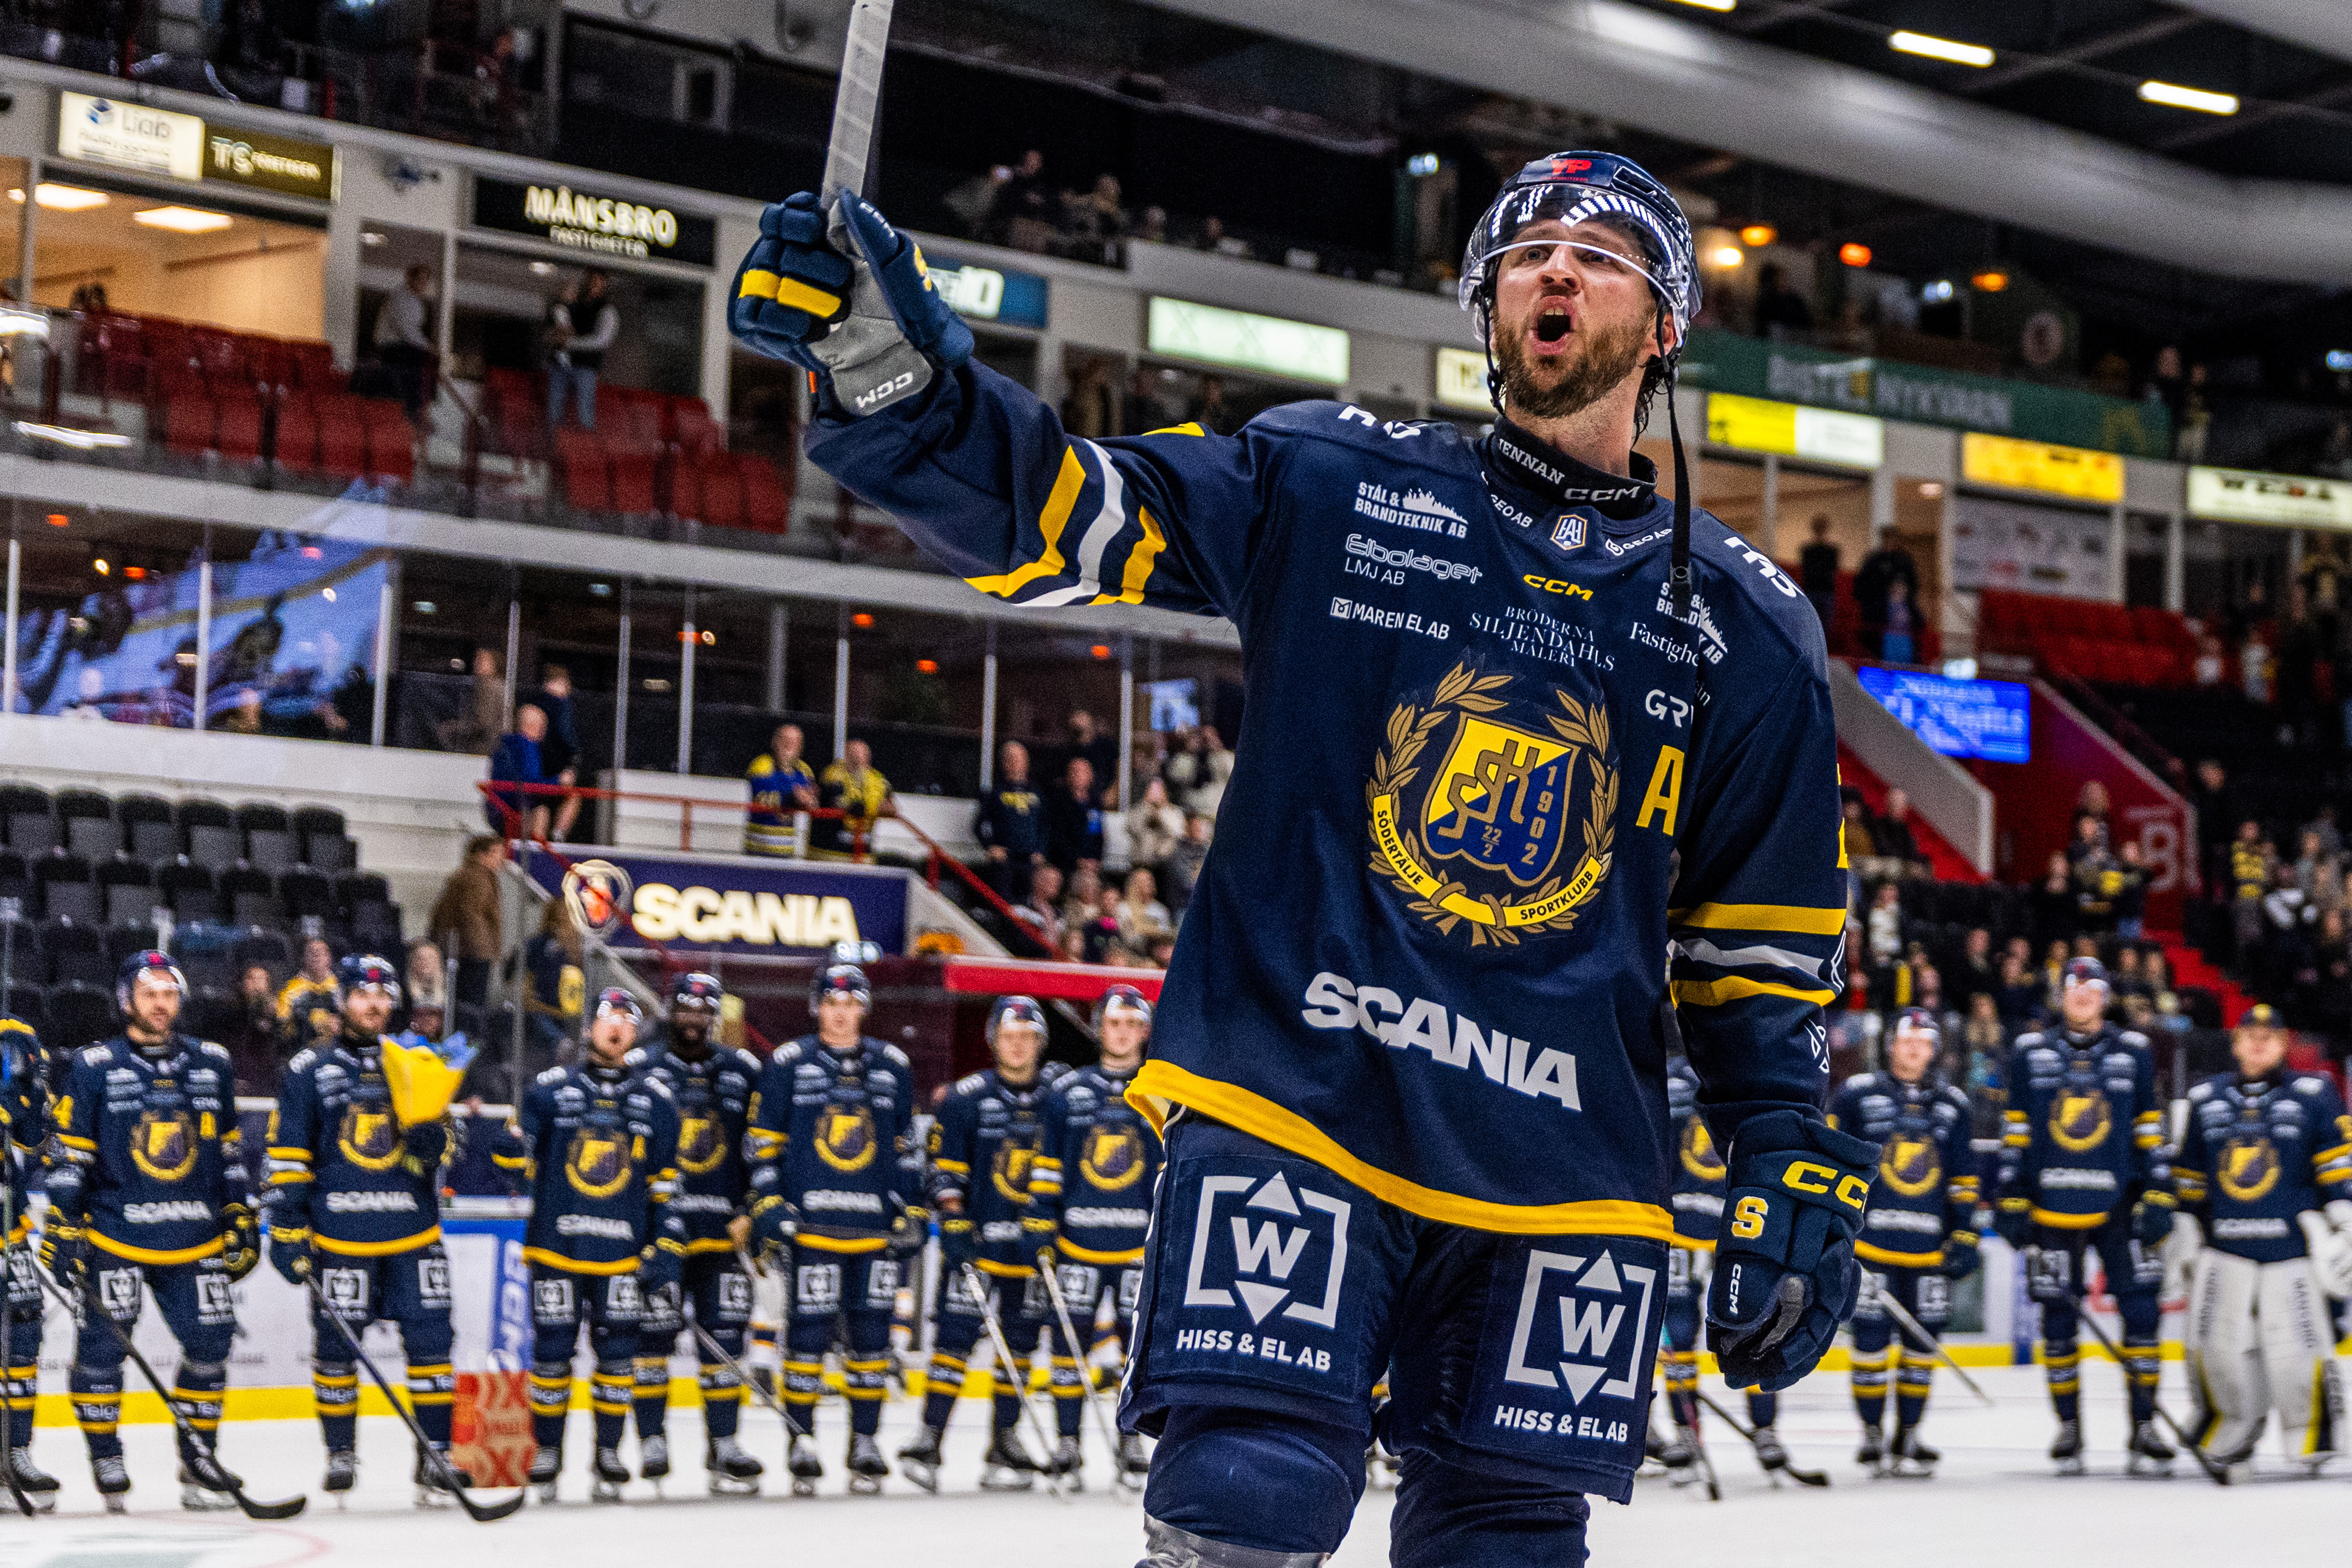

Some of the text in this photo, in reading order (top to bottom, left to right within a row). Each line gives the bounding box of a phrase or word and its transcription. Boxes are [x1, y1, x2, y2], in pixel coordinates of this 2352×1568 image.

[525, 186, 675, 247] MÅNSBRO
[855, 371, 914, 409] CCM
[1358, 482, 1400, 507] STÅL &
[1565, 486, 1641, 501] CCM
[1354, 497, 1468, 539] BRANDTEKNIK AB
[1345, 557, 1405, 585] LMJ AB
[1346, 533, 1483, 584] Elbolaget
[1523, 574, 1594, 601] CCM
[1426, 621, 1450, 639] AB
[1469, 612, 1615, 671] SILJENDAHLS
[1505, 606, 1594, 642] BRÖDERNA
[1703, 644, 1724, 664] AB
[1645, 688, 1694, 728] GR
[1636, 745, 1685, 837] A
[1377, 810, 1424, 885] SÖDERTÄLJE
[632, 882, 861, 946] SCANIA
[1520, 870, 1594, 920] SPORTKLUBB
[1301, 971, 1583, 1112] SCANIA
[326, 1191, 418, 1212] SCANIA
[1782, 1161, 1870, 1213] CC
[124, 1201, 212, 1224] SCANIA
[1731, 1195, 1769, 1240] S
[1230, 1216, 1312, 1279] W
[1729, 1263, 1742, 1316] CCM
[1559, 1295, 1627, 1358] W
[1176, 1329, 1331, 1372] HISS & EL AB
[1494, 1405, 1628, 1443] HISS & EL AB
